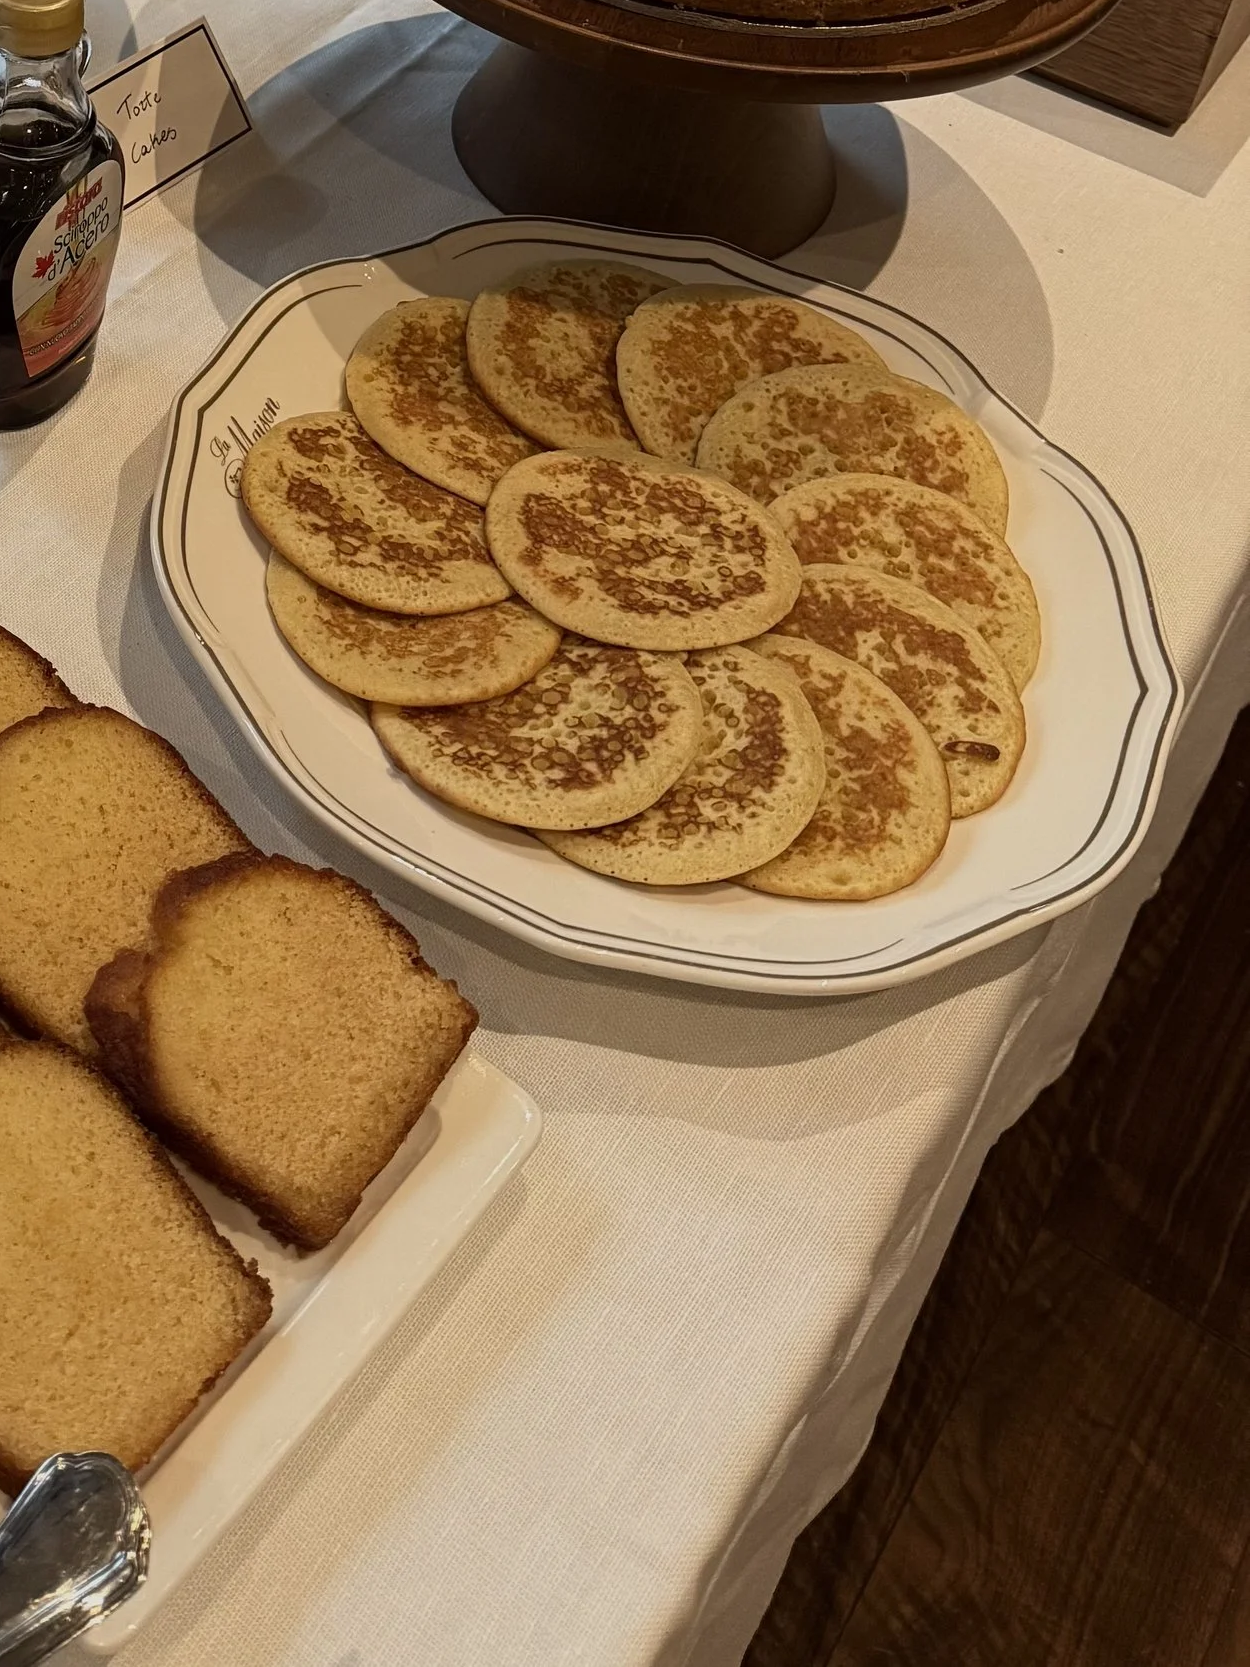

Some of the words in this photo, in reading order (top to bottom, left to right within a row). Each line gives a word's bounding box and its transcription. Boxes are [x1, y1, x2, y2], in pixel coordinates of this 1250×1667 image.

[116, 90, 162, 120] Torte
[131, 127, 177, 164] Cakes
[47, 213, 110, 282] d'Acero
[53, 196, 109, 254] Sciroppo
[209, 435, 232, 466] La
[226, 397, 281, 458] Maison
